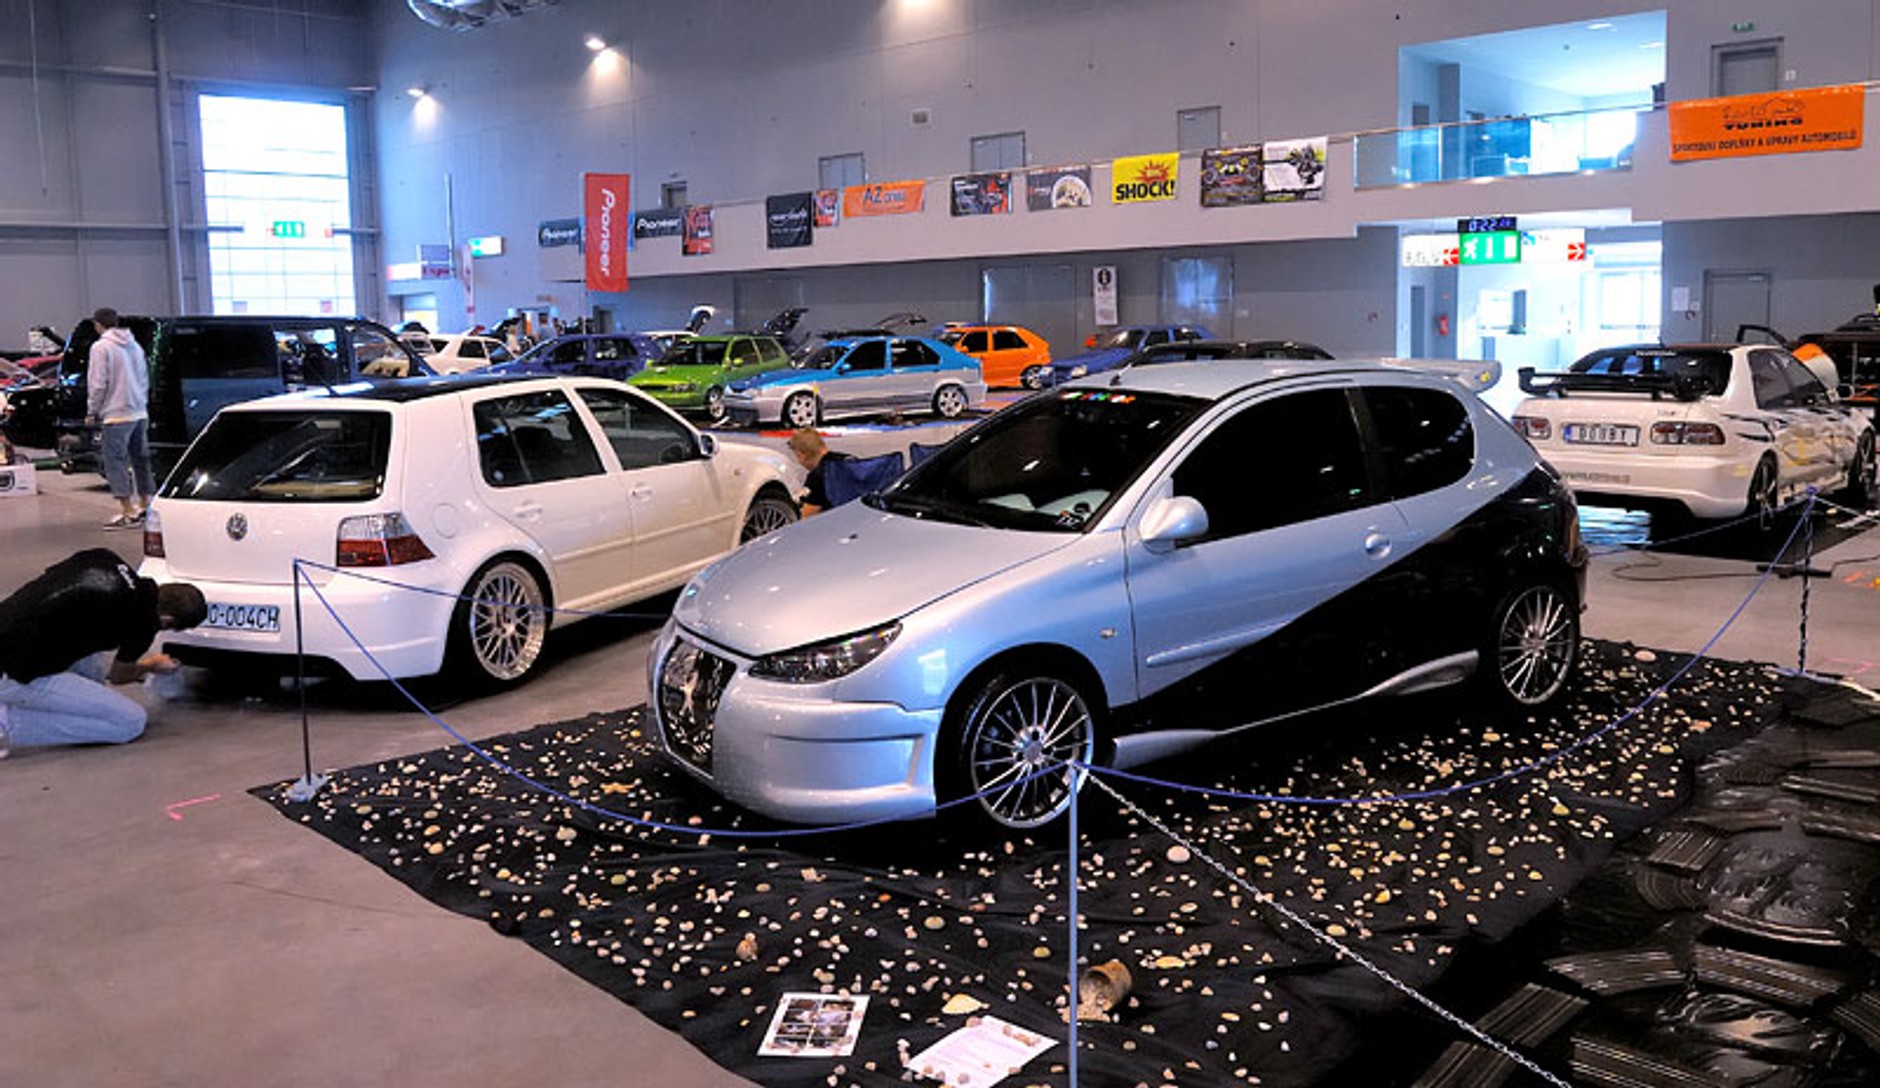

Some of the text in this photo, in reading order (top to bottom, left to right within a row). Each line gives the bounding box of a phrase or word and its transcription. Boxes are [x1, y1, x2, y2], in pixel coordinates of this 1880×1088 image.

[1116, 180, 1175, 201] SHOCK!
[600, 188, 616, 277] Pioneer
[637, 218, 681, 230] Pioneer
